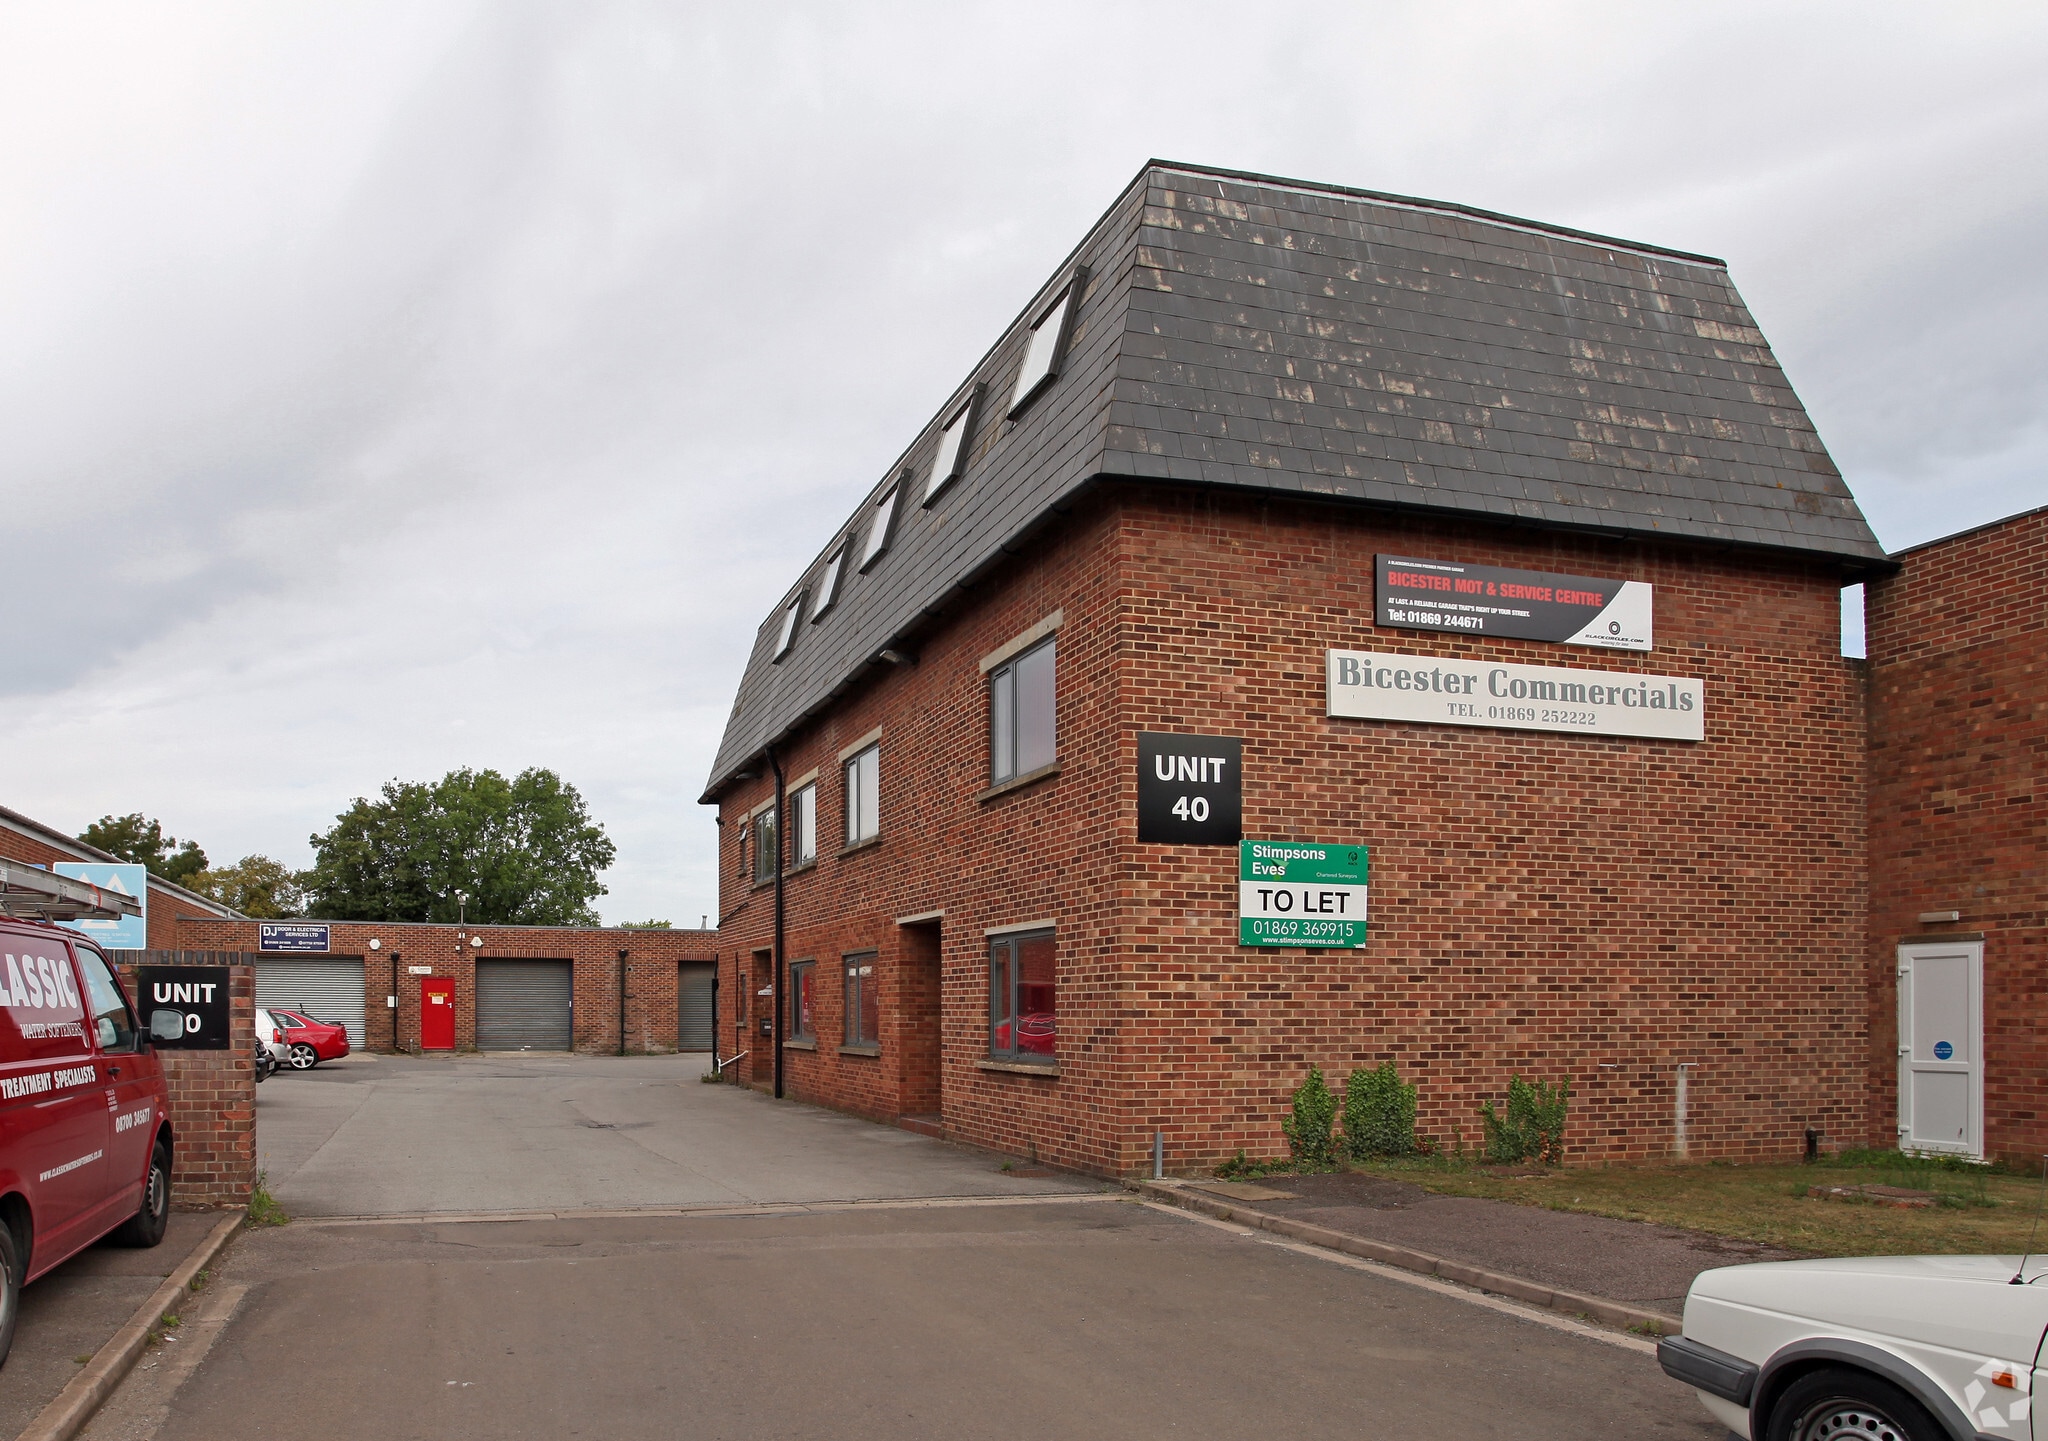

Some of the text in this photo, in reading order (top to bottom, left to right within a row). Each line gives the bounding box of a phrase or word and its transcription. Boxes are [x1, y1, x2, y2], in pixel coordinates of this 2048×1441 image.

[1388, 571, 1603, 607] BICESTER MOT & SERVICE CENTRE
[1414, 600, 1437, 609] RELIABLE
[1438, 602, 1458, 611] GARAGE
[1458, 604, 1475, 612] THAT'S
[1475, 606, 1490, 614] RIGHT
[1498, 608, 1511, 616] YOUR
[1388, 608, 1483, 629] Tel: 01869 244671
[1337, 657, 1694, 711] Bicester Commercials
[1447, 702, 1596, 725] TEL. 01869 252222
[1155, 754, 1226, 783] UNIT
[1172, 796, 1210, 822] 40
[1252, 845, 1326, 861] Stimpsons
[1252, 862, 1286, 876] Eves
[1316, 871, 1338, 879] Chartered
[1257, 890, 1351, 913] TO LET
[263, 926, 277, 937] DJ
[1253, 920, 1354, 937] 01869 369915
[1262, 937, 1345, 947] www.stimpsonseves.co.uk
[153, 982, 217, 1003] UNIT
[20, 1022, 83, 1039] WATER SOFTENERS
[185, 1013, 202, 1033] 0
[0, 1065, 96, 1099] TREATMENT SPECIALISTS
[116, 1113, 133, 1133] 08700
